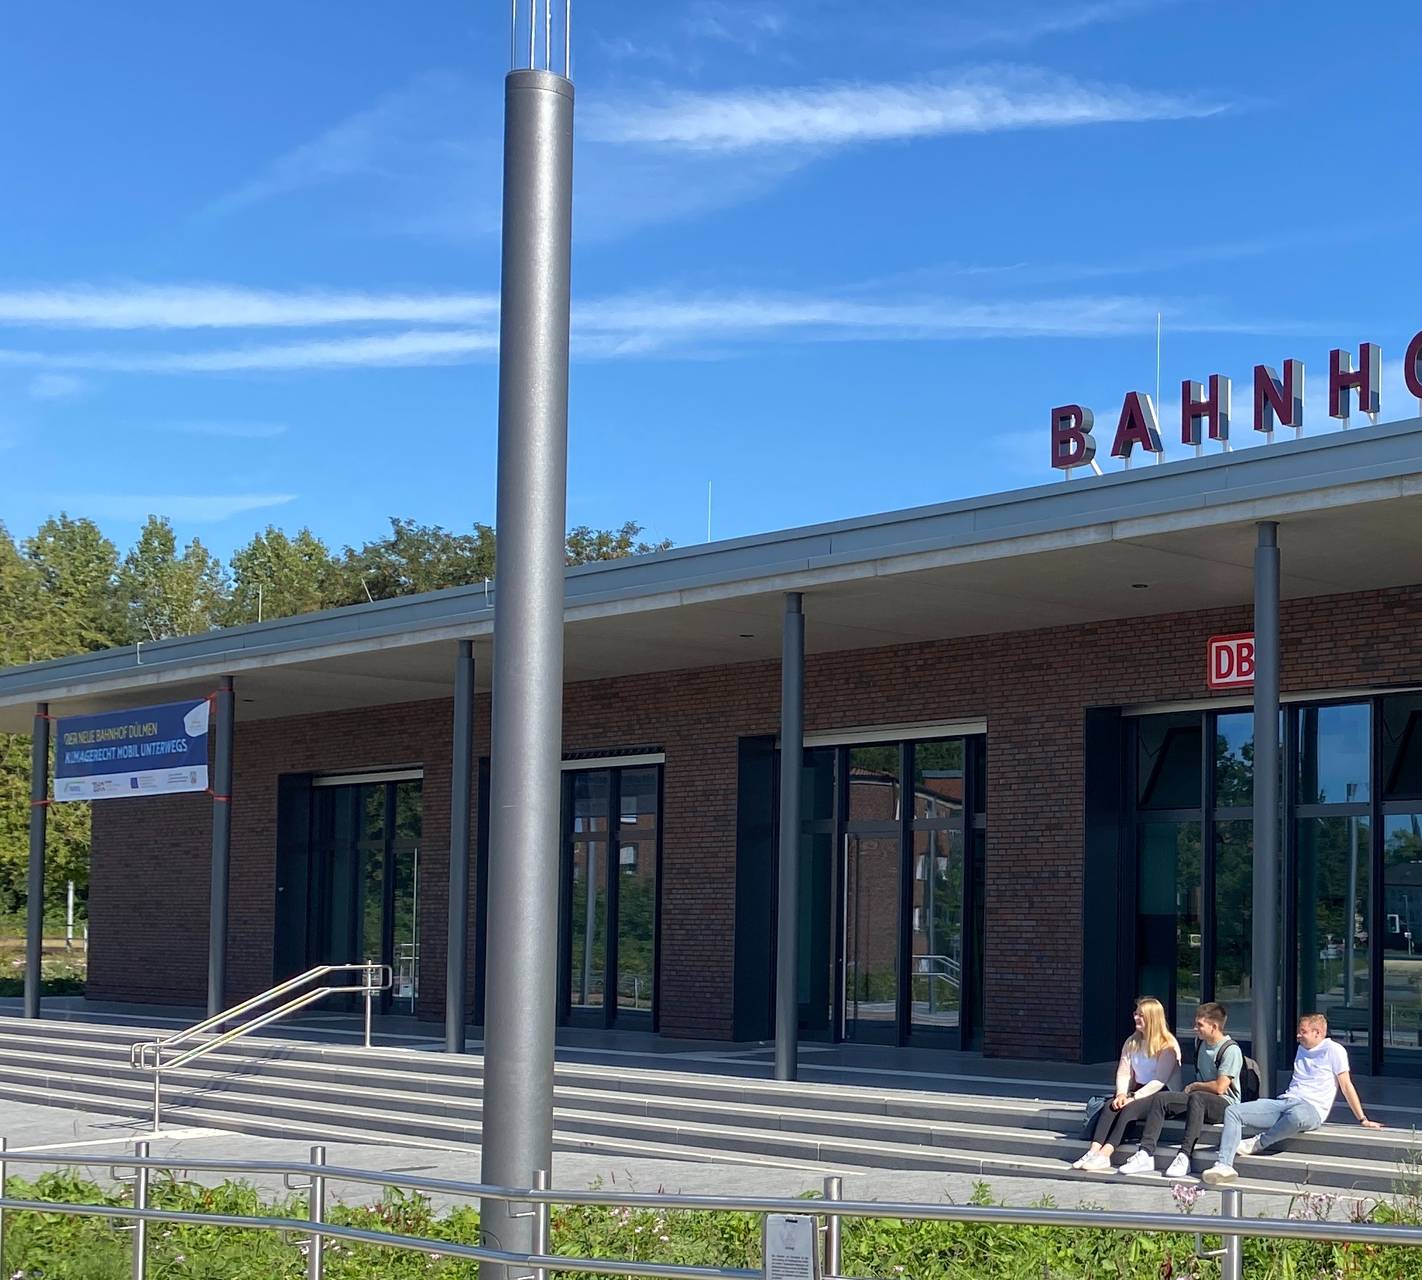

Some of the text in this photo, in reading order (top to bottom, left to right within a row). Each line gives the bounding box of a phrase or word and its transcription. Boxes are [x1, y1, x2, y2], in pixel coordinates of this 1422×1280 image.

[1215, 642, 1255, 679] DB
[64, 721, 158, 745] DER NEUE BAHNHOF DÜLMEN
[65, 739, 188, 764] KLIMAGERECHT MOBIL UNTERWEGS
